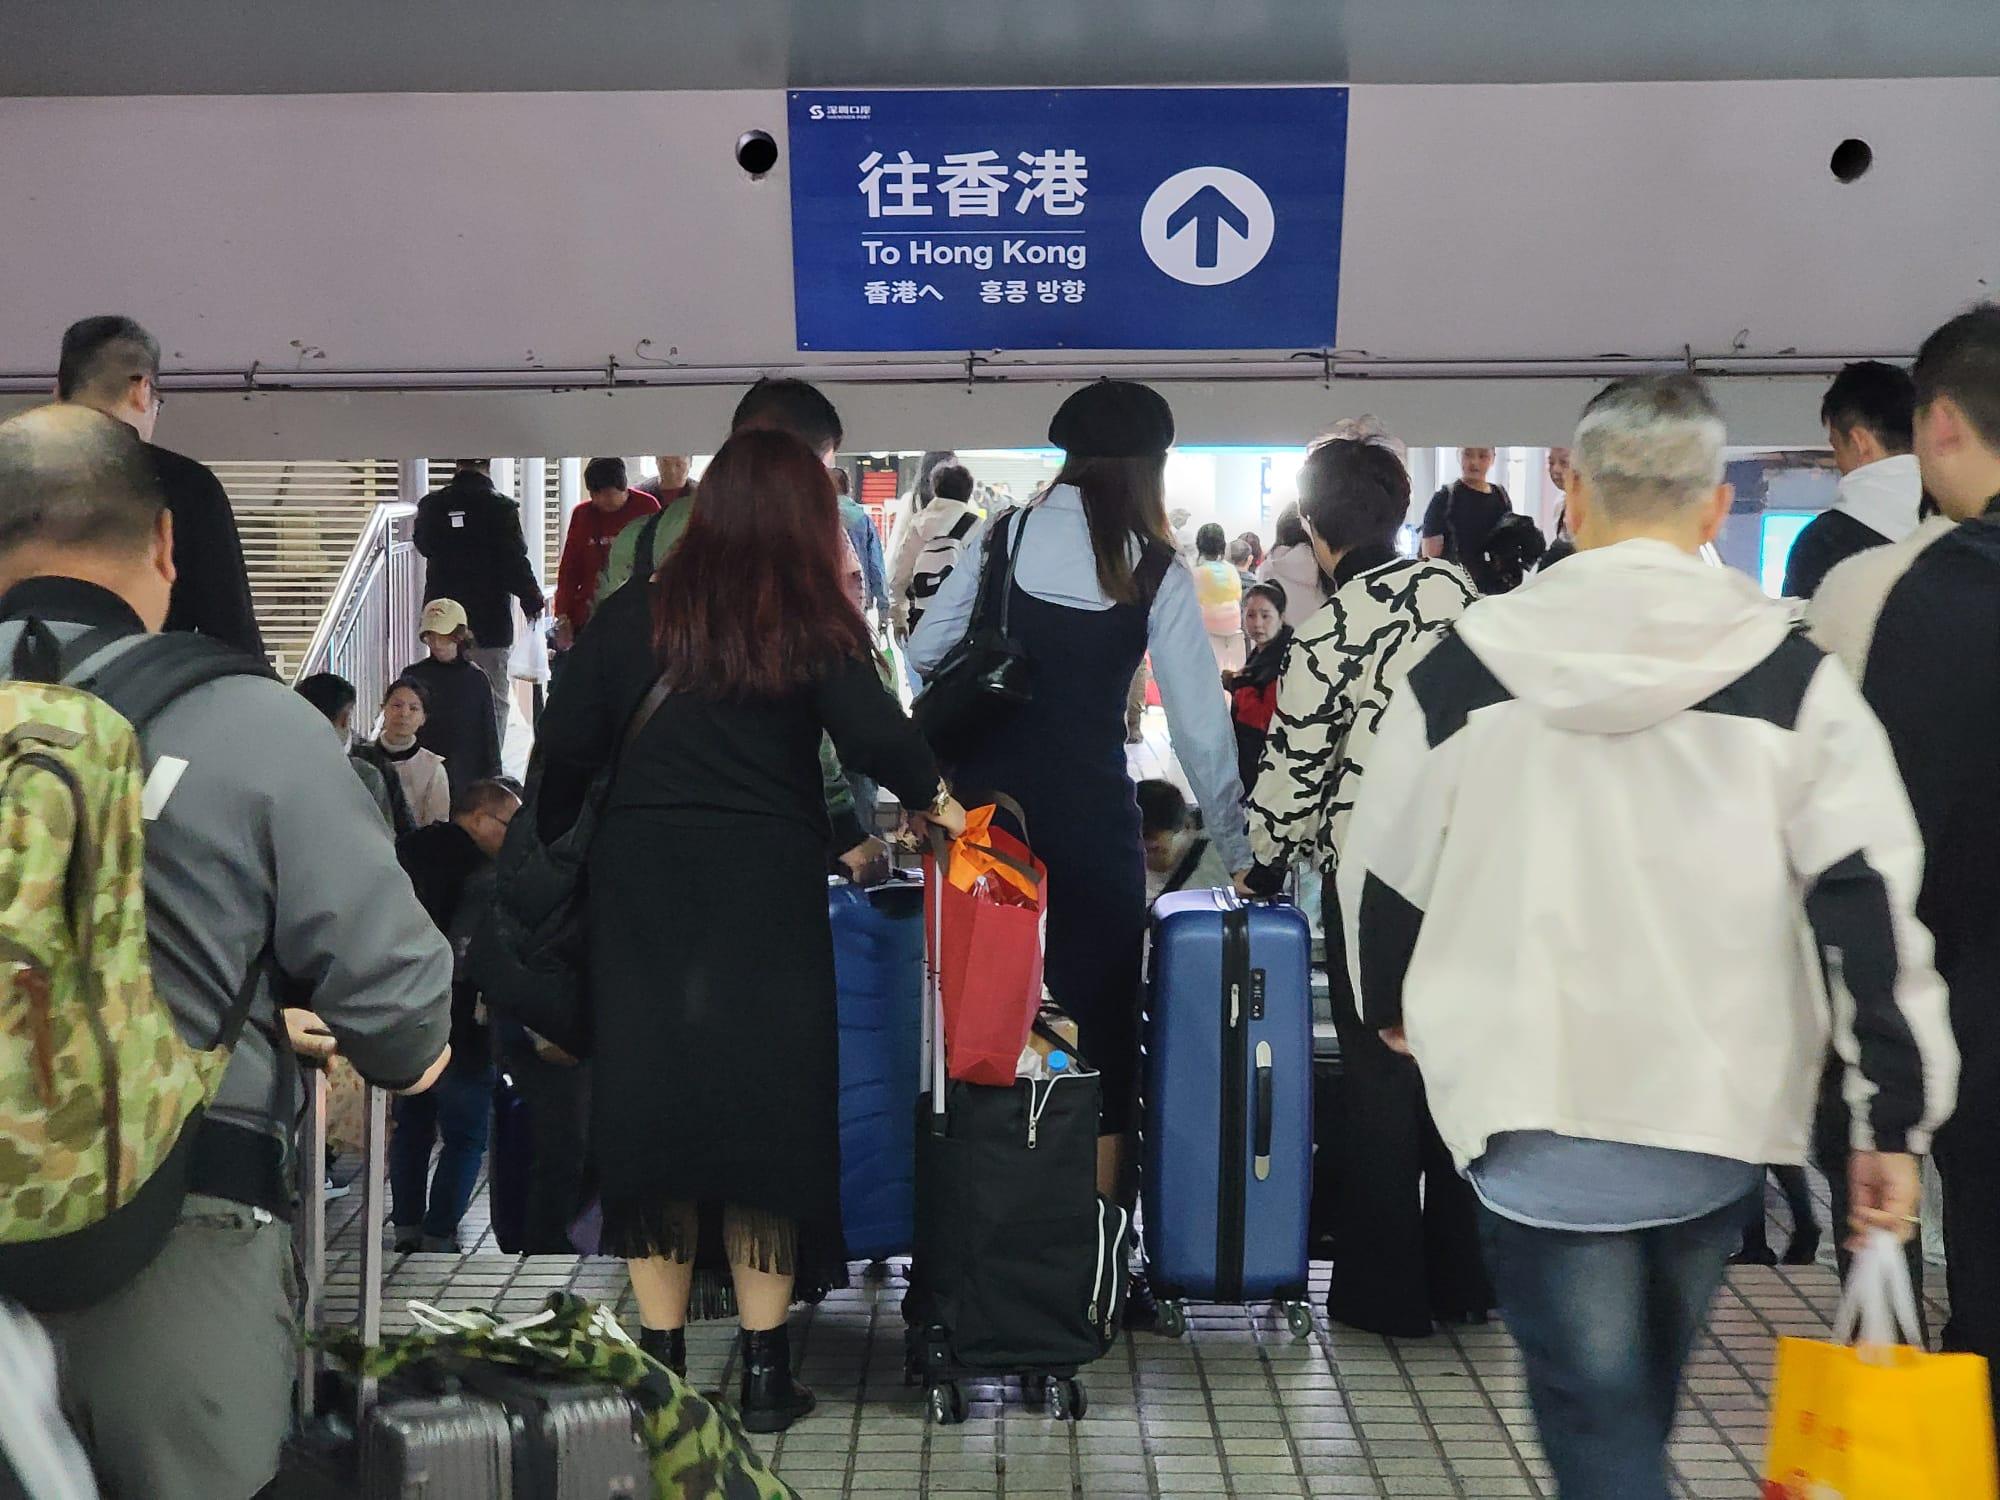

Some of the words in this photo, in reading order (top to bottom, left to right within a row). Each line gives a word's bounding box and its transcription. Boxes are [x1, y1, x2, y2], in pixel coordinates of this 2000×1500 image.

[859, 149, 1088, 217] 往香港
[862, 240, 900, 264] To
[910, 240, 993, 270] Hong
[1003, 239, 1086, 270] Kong
[864, 280, 944, 304] 香港へ
[979, 280, 1029, 304] 홍콩
[1037, 279, 1086, 304] 방향
